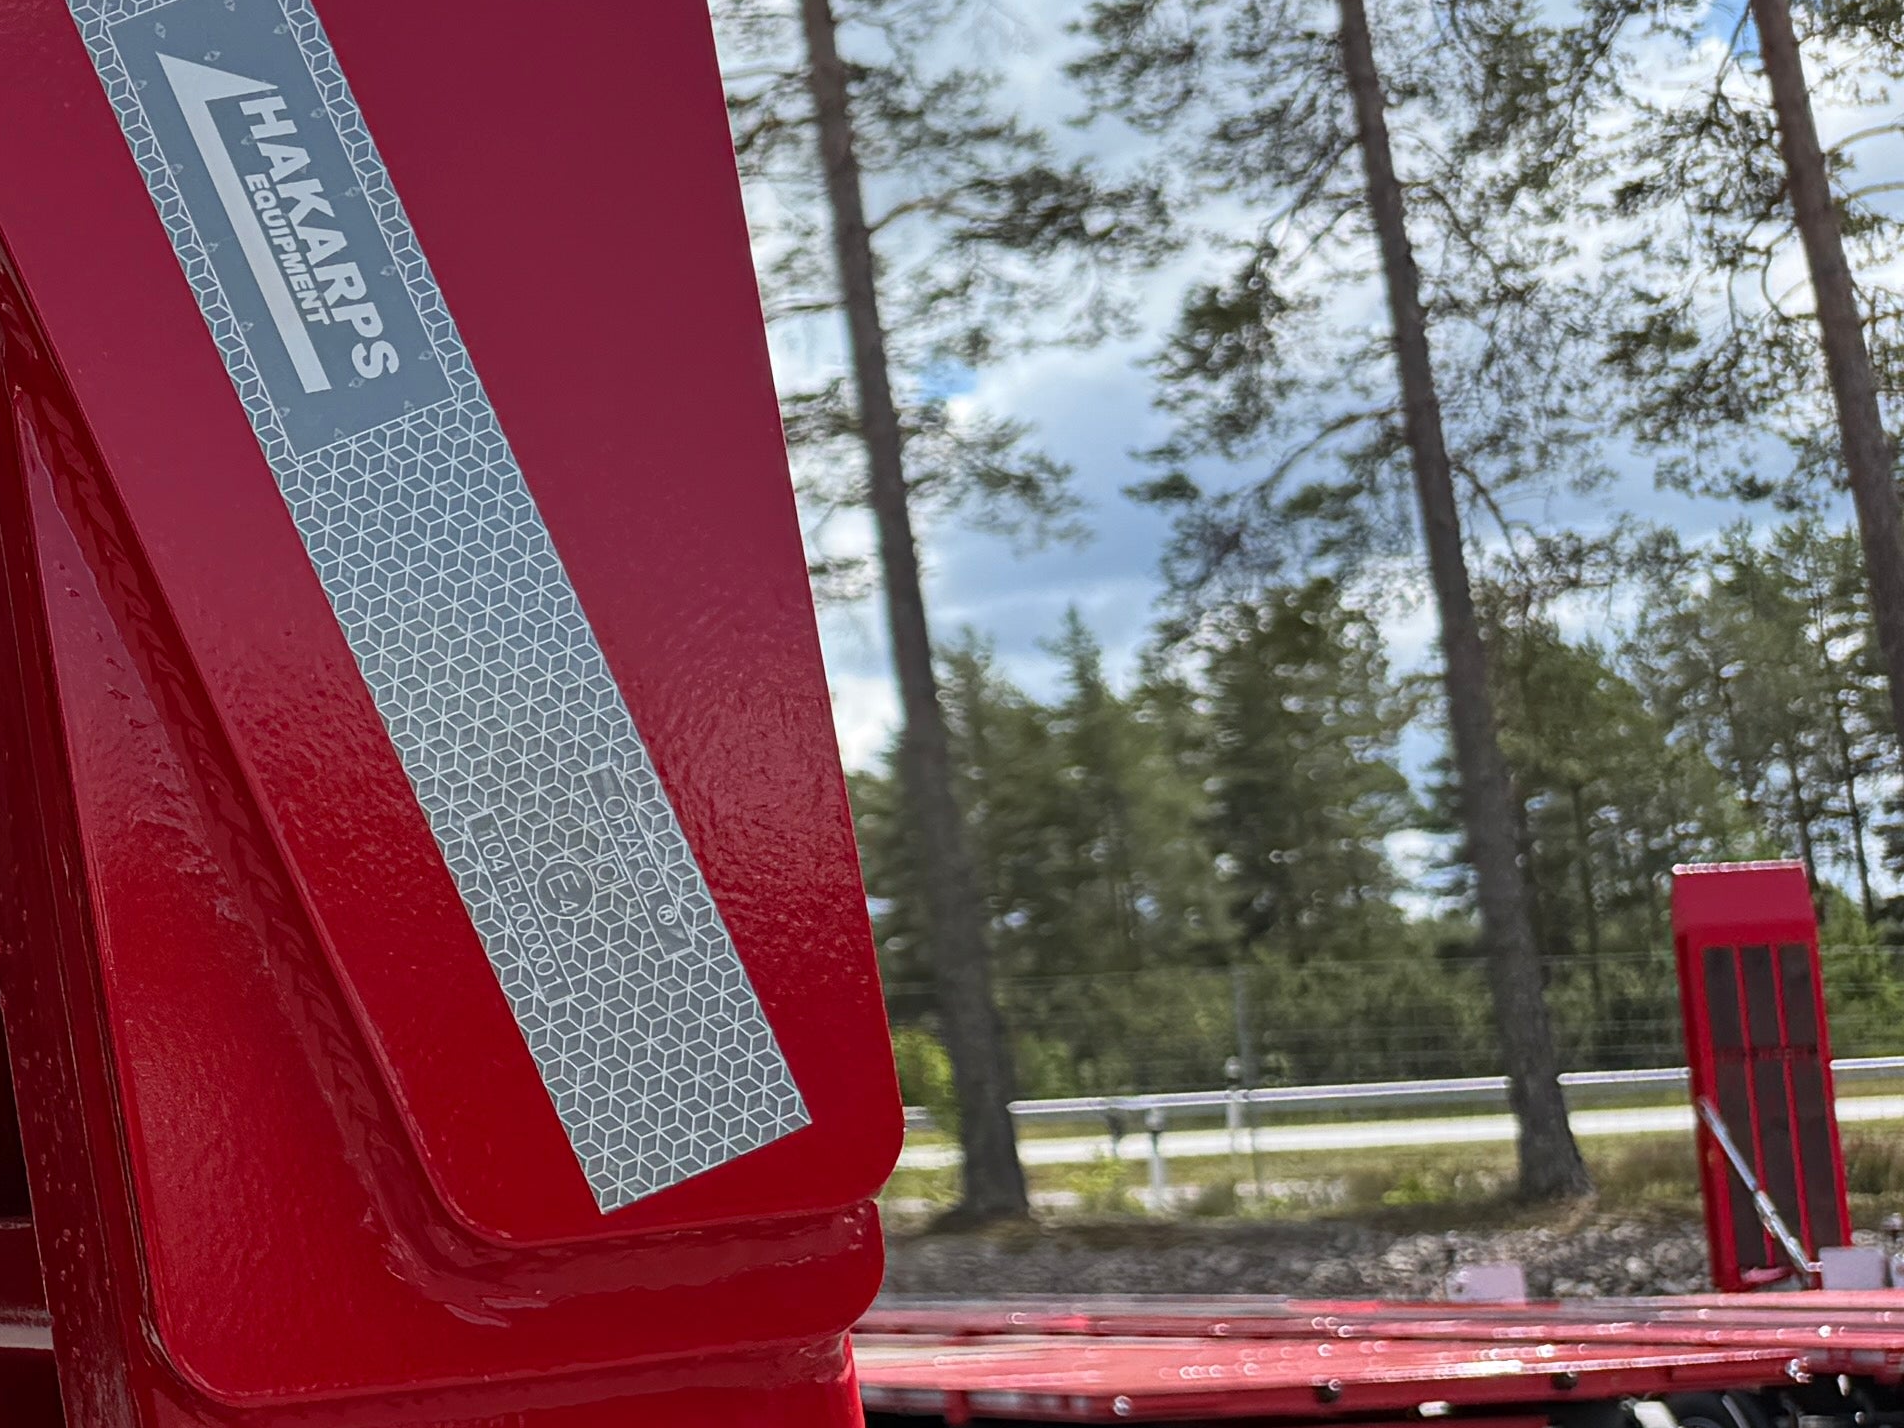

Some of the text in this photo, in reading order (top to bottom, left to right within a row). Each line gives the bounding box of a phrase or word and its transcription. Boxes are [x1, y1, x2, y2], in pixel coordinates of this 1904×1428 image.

[239, 95, 400, 379] HAKARPS
[244, 173, 330, 325] EQUIPMENT
[478, 830, 511, 872] 104
